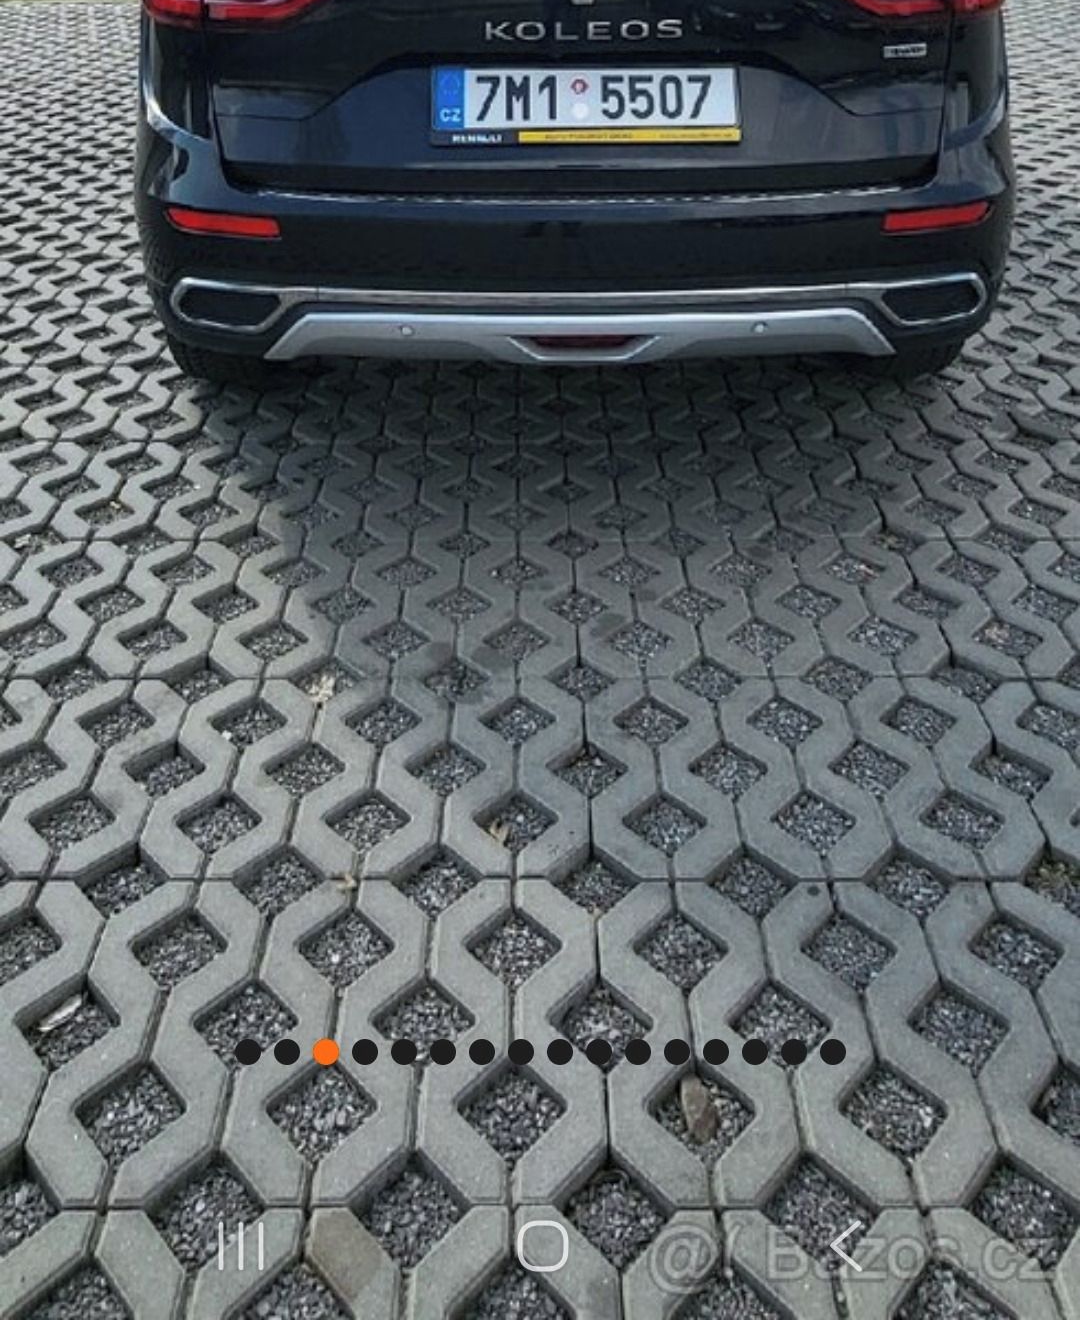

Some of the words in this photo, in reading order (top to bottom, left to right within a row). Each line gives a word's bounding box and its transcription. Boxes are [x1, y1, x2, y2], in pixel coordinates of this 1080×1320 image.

[485, 19, 683, 40] KOLEOS
[476, 74, 557, 121] 7M1
[601, 75, 711, 120] 5507
[440, 108, 461, 122] CZ
